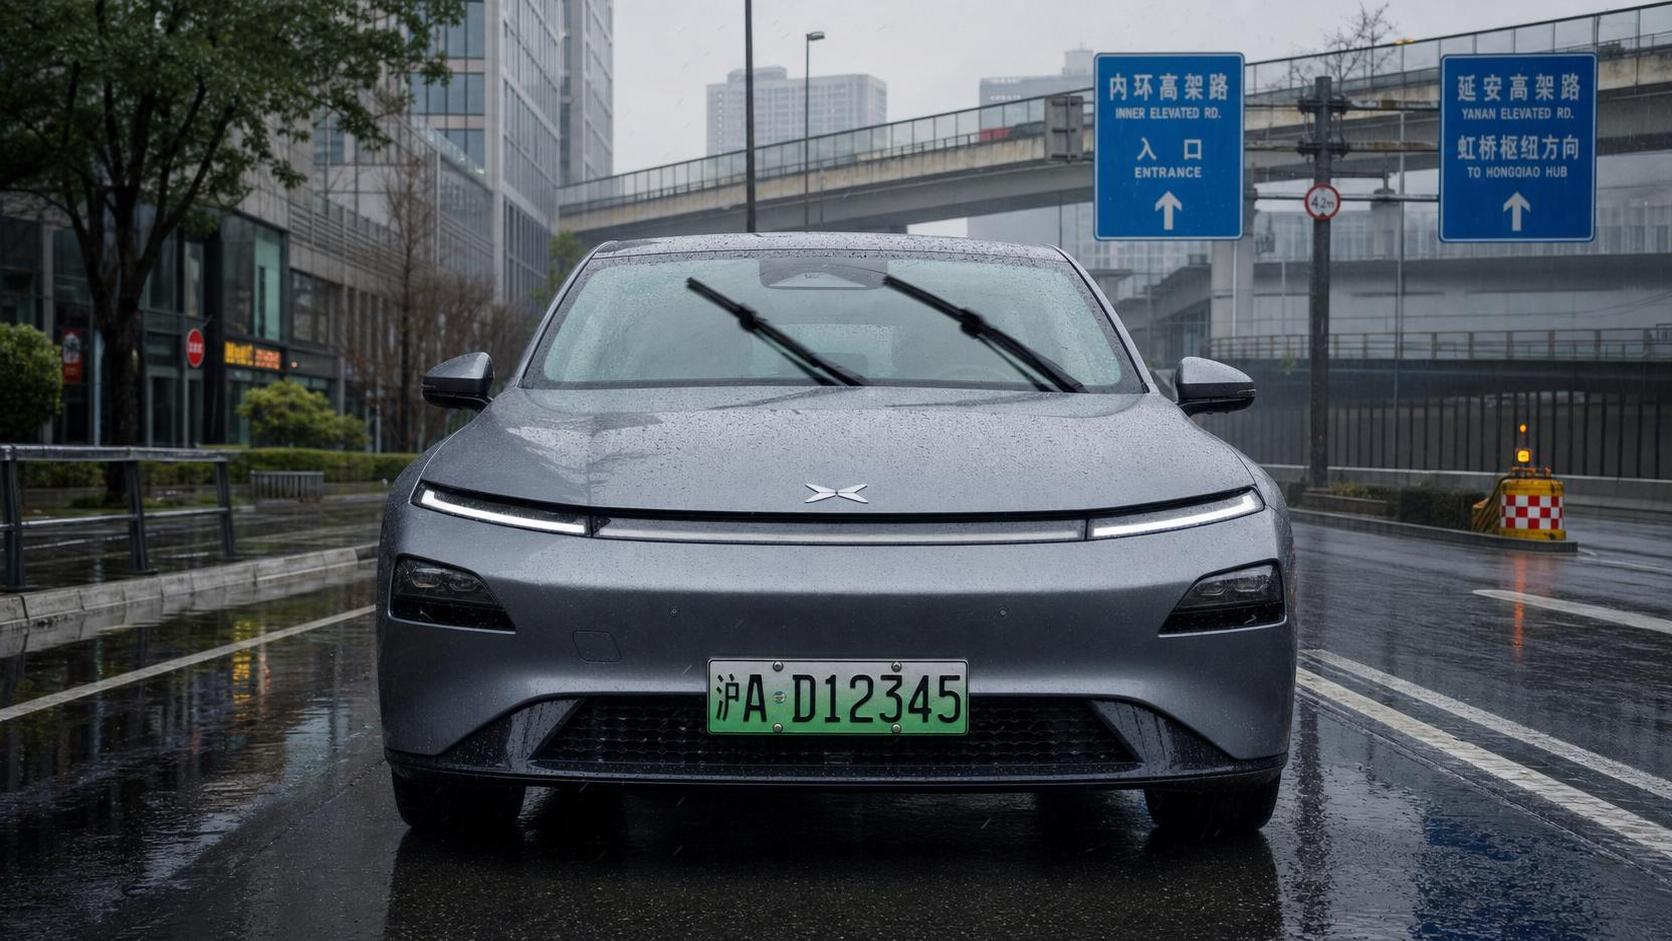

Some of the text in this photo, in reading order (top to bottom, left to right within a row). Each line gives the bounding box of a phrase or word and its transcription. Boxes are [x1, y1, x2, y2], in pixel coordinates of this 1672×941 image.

[1109, 73, 1228, 101] 内环高架路
[1457, 73, 1580, 101] 延安高架路
[1115, 107, 1221, 119] INNER ELEVATED RD.
[1462, 107, 1574, 120] YANAN ELEVATED RD.
[1136, 137, 1202, 160] 入口
[1457, 134, 1579, 160] 虹桥枢纽方向
[1134, 166, 1202, 178] ENTRANCE
[1467, 166, 1568, 178] TO HONGQIAO HUB
[716, 673, 961, 723] 沪A D12345
